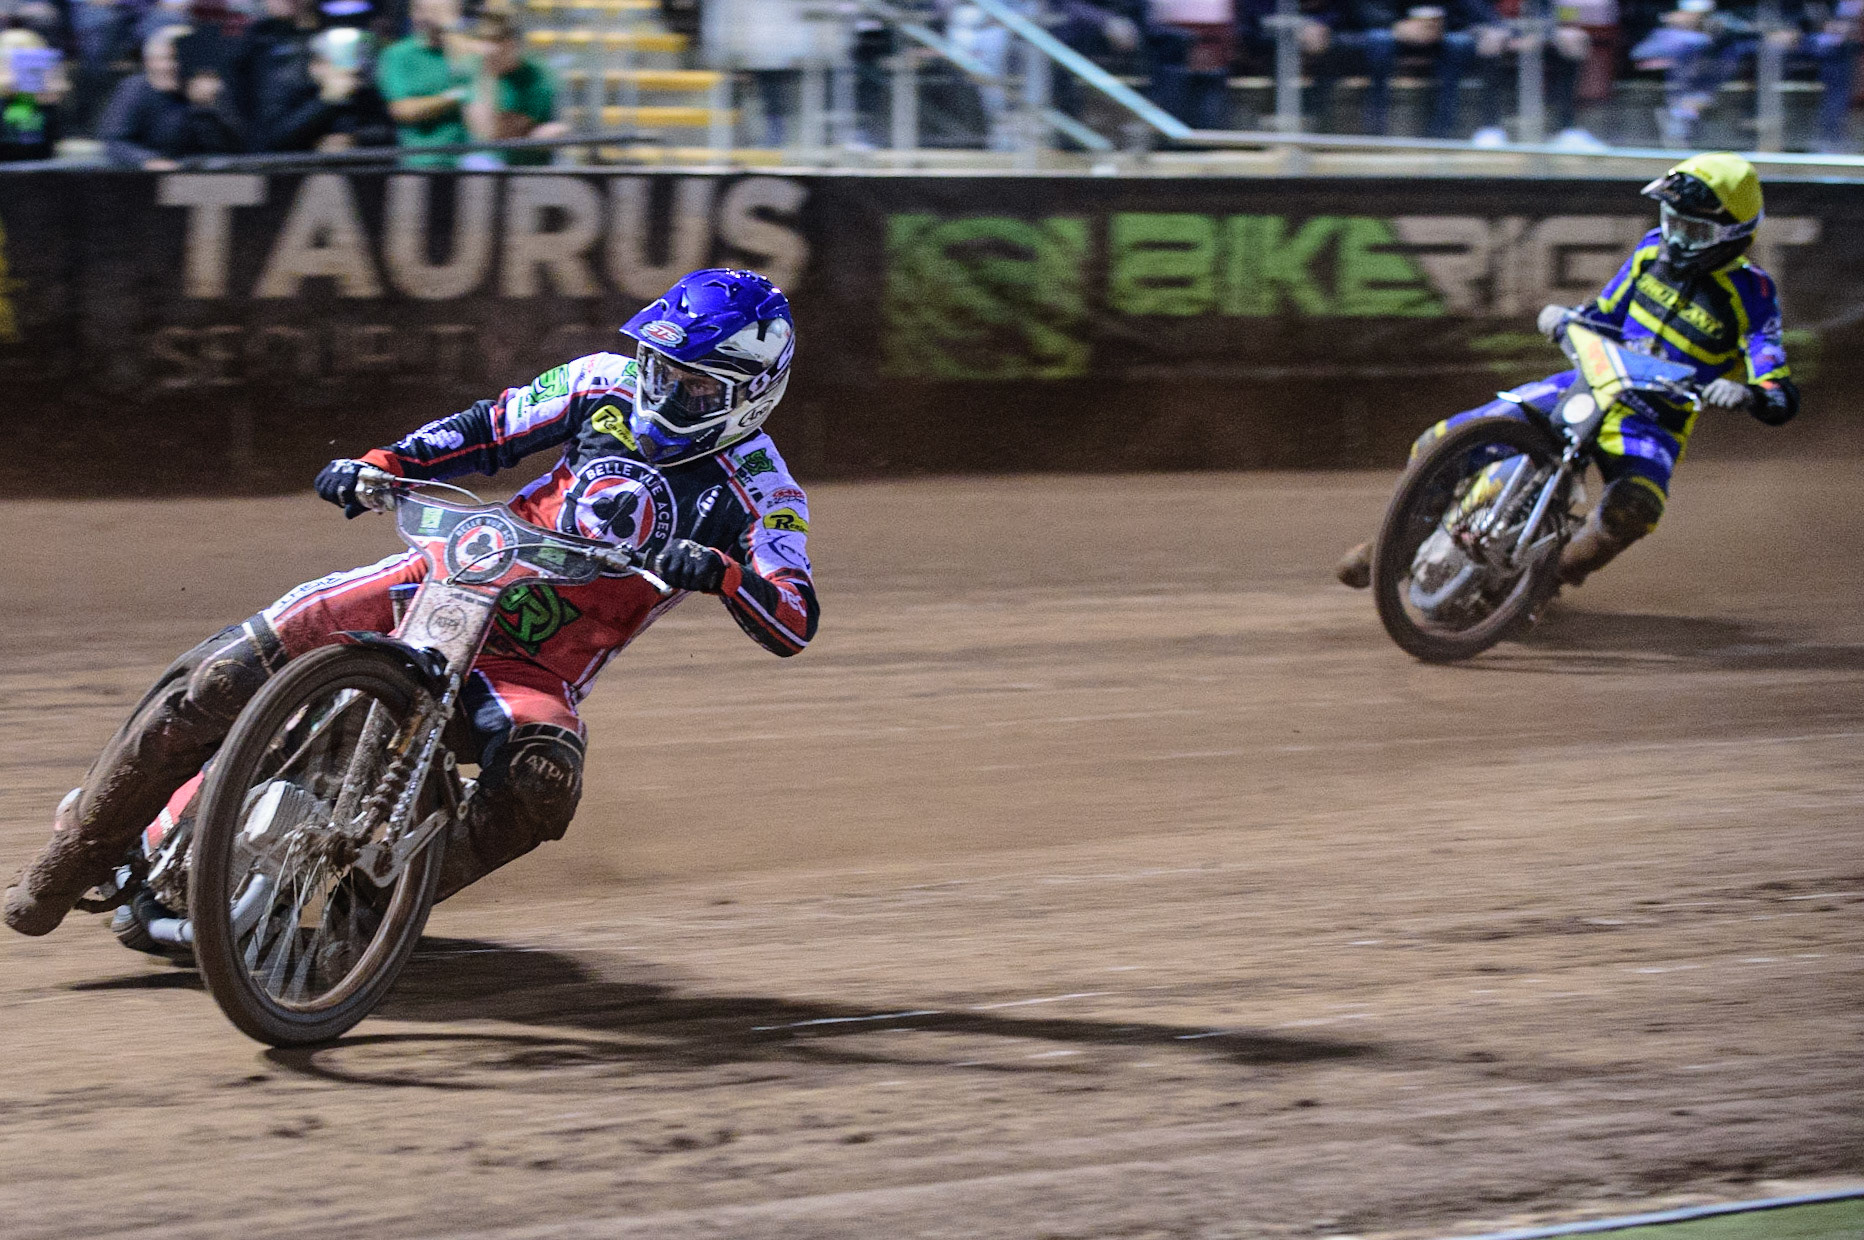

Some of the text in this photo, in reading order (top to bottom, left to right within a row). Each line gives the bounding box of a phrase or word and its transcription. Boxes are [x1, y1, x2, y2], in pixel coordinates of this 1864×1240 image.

[158, 173, 808, 300] TAURUS
[1107, 212, 1824, 320] BIKERIGT
[585, 462, 670, 540] BELLE VUE ACES
